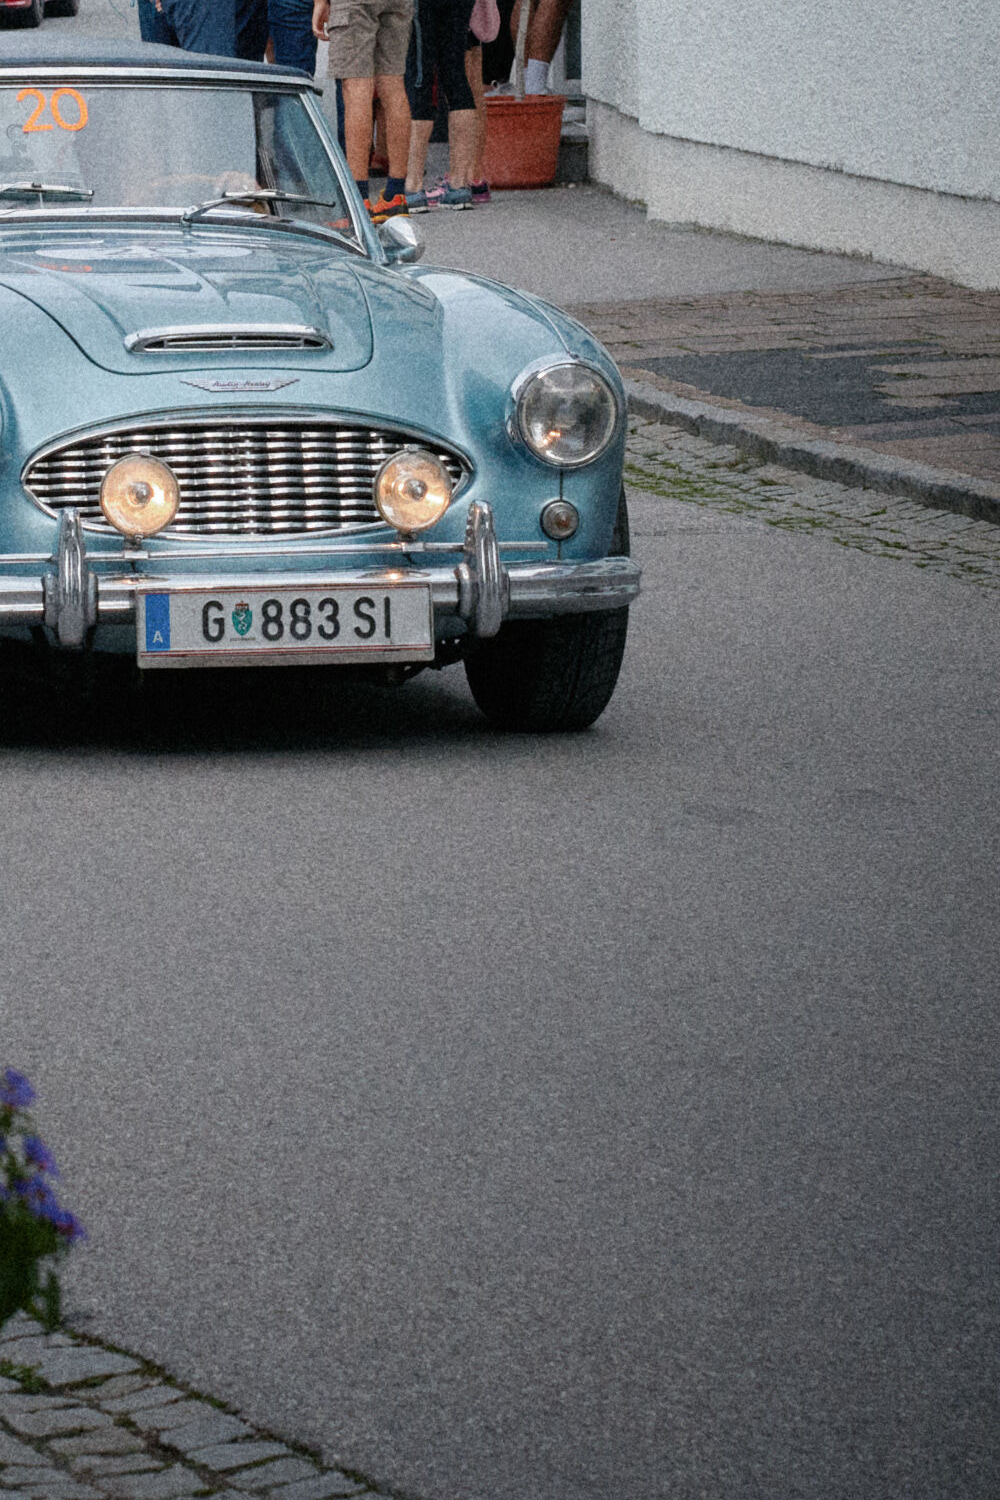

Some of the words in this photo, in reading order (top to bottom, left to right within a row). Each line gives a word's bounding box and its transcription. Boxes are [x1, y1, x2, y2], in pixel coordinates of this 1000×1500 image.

[16, 87, 89, 133] 20
[152, 630, 164, 644] A
[202, 599, 225, 643] G
[261, 597, 341, 642] 883
[353, 595, 391, 639] SI
